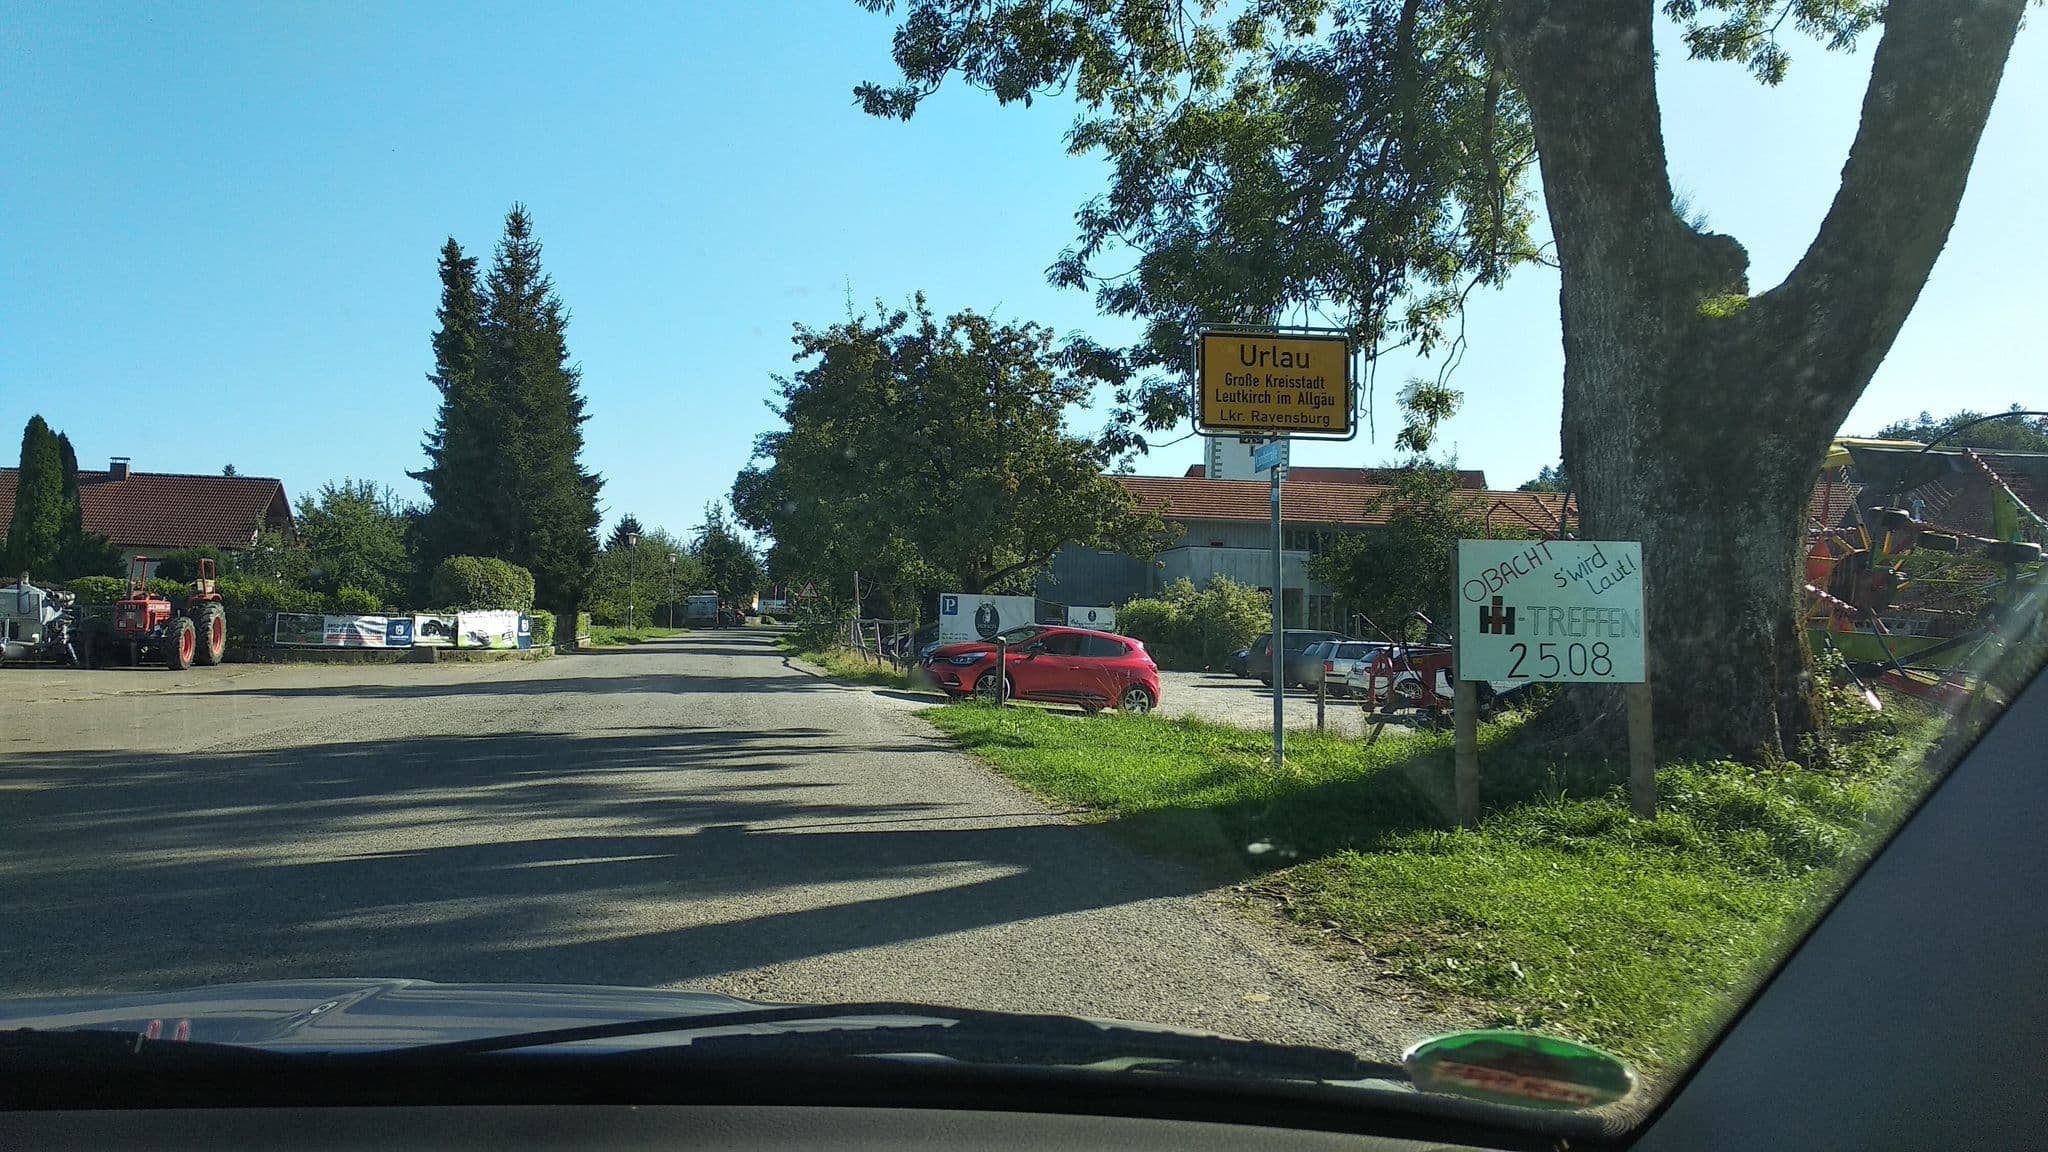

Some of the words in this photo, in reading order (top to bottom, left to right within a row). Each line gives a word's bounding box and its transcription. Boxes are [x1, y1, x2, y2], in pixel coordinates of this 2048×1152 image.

[1240, 344, 1309, 369] Urlau
[1225, 372, 1259, 388] Große
[1265, 374, 1325, 389] Kreisstadt
[1215, 388, 1271, 404] Leutkirch
[1277, 390, 1291, 405] im
[1297, 391, 1335, 409] Allgäu
[1220, 409, 1246, 422] Lkr.
[1251, 410, 1330, 427] Ravensburg
[1463, 540, 1553, 602] OBACHT
